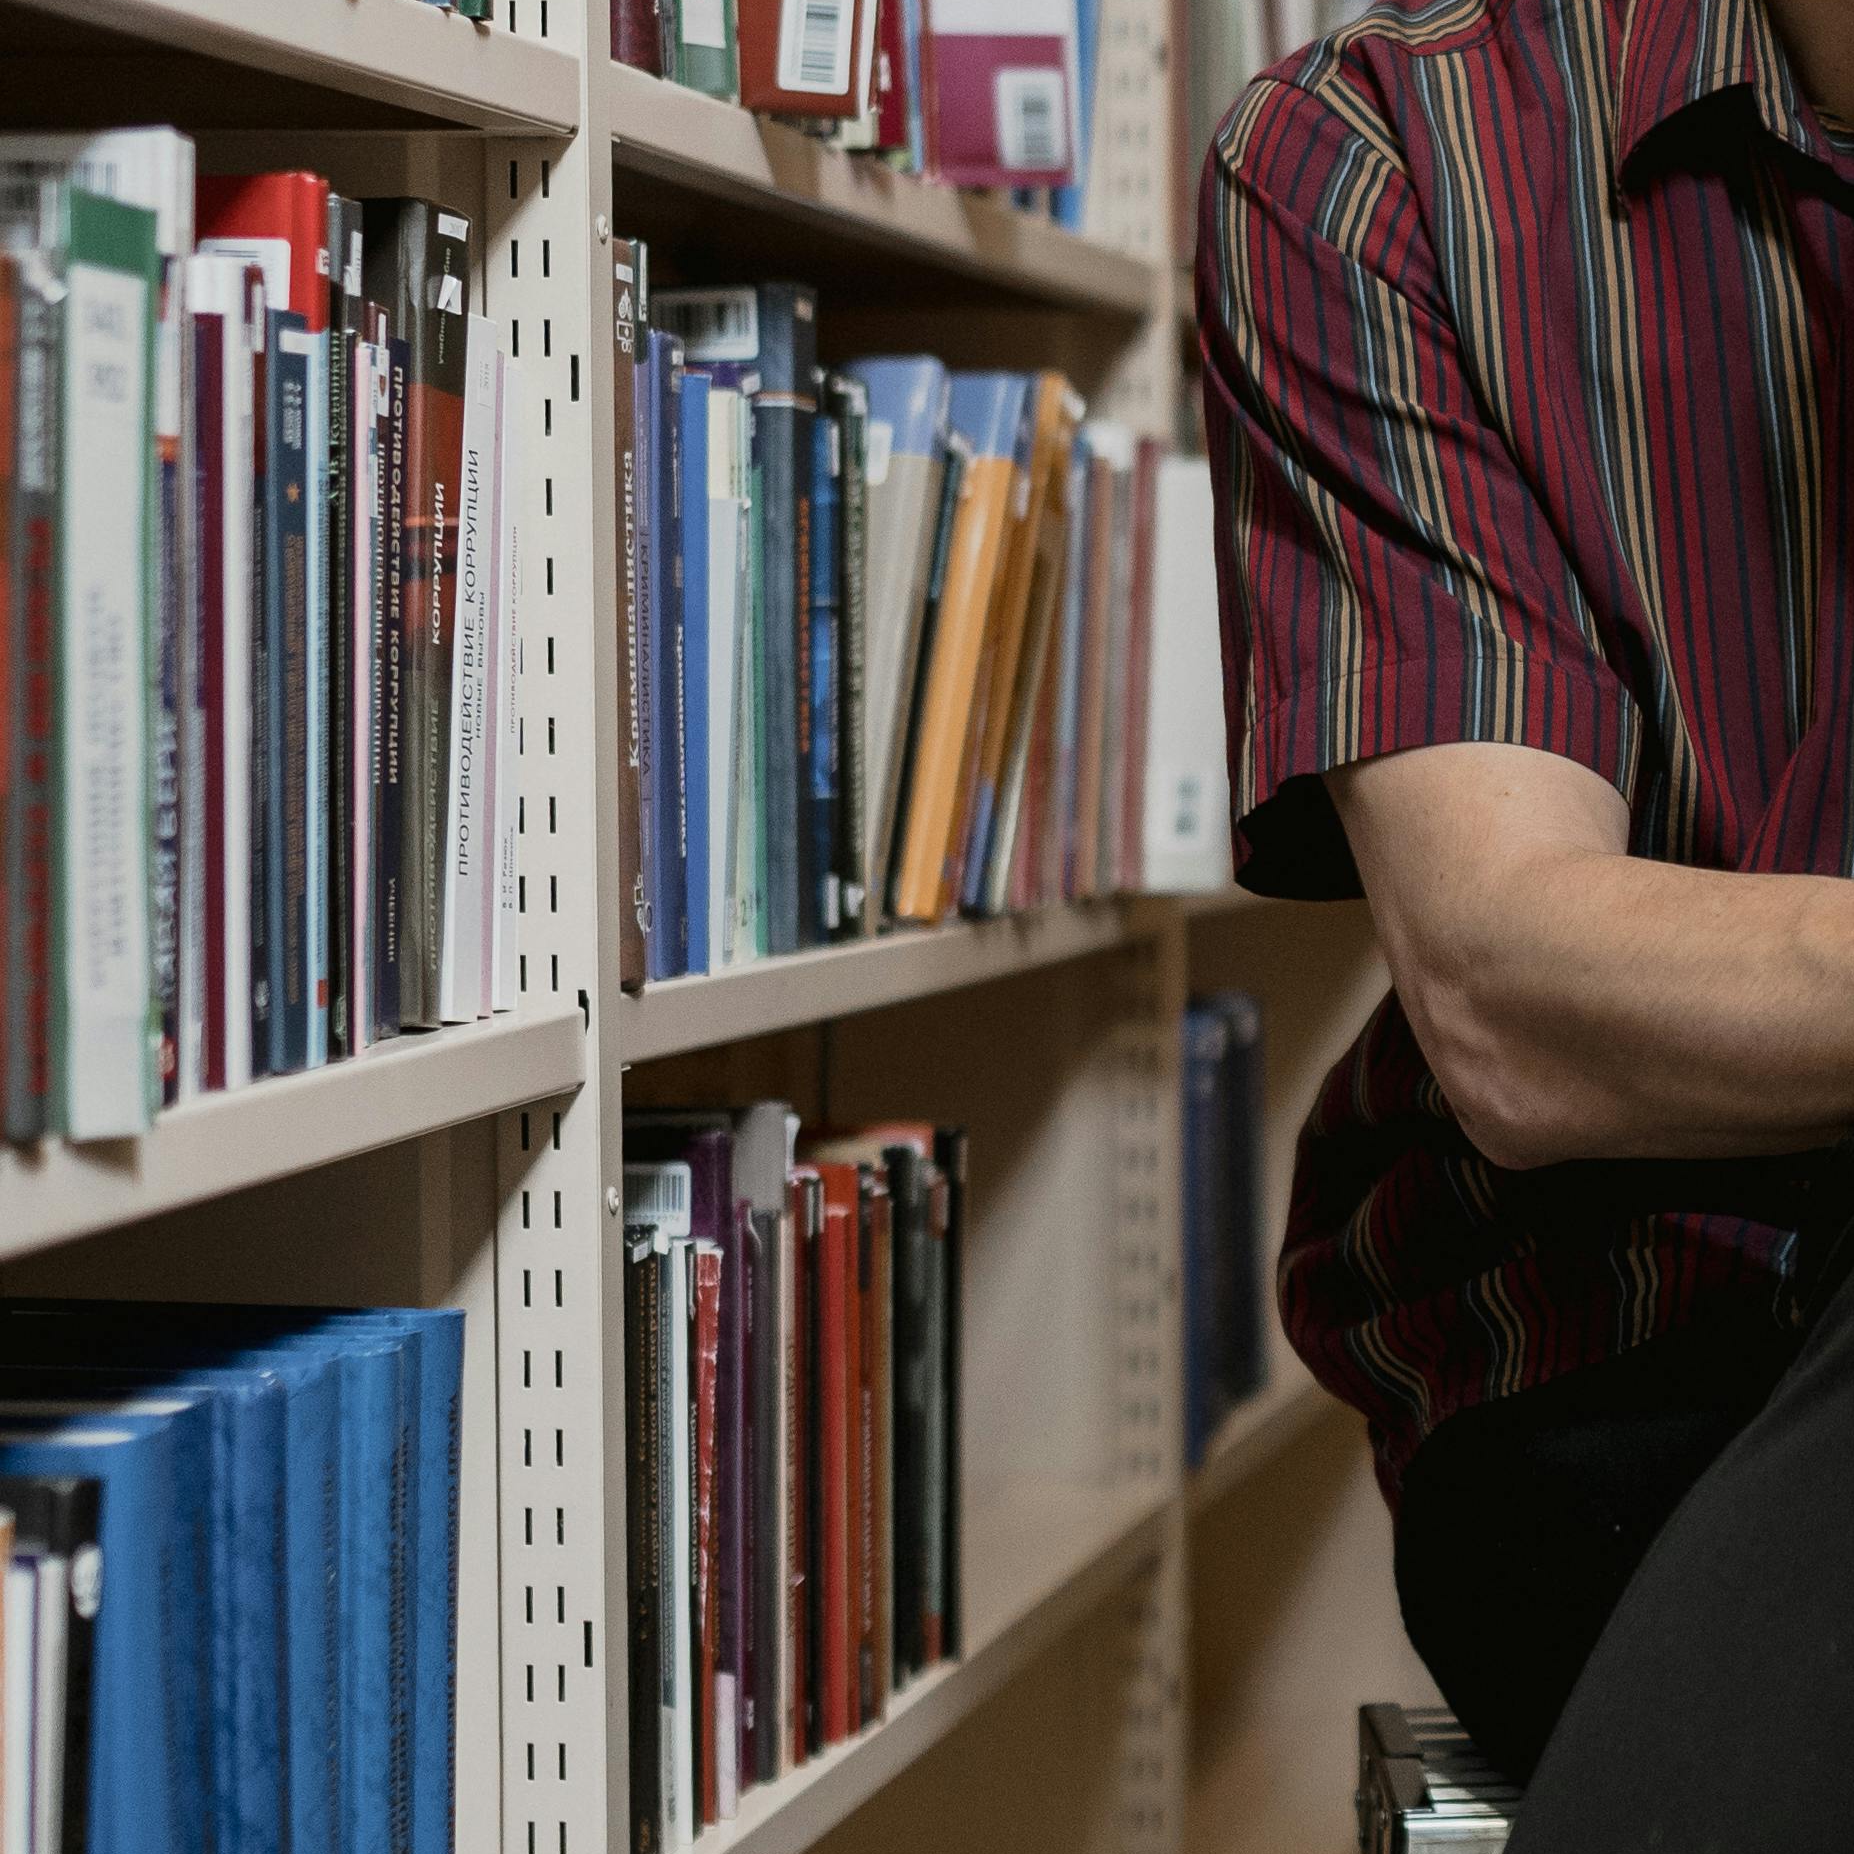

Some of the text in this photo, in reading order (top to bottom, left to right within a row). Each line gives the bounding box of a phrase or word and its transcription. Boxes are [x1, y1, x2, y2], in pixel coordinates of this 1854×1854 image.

[390, 365, 404, 619] ПРОТИВОДЕЙСТВИЕ
[432, 482, 446, 645] КОРРУПЦИИ
[624, 450, 641, 768] Криминалистика
[388, 629, 400, 784] КОРРУПЦИИ
[458, 449, 480, 877] ПРОТИВОДЕЙСТВИЕ КОРРУПЦИИ
[639, 543, 652, 777] КРИМИНАЛИСТИКА
